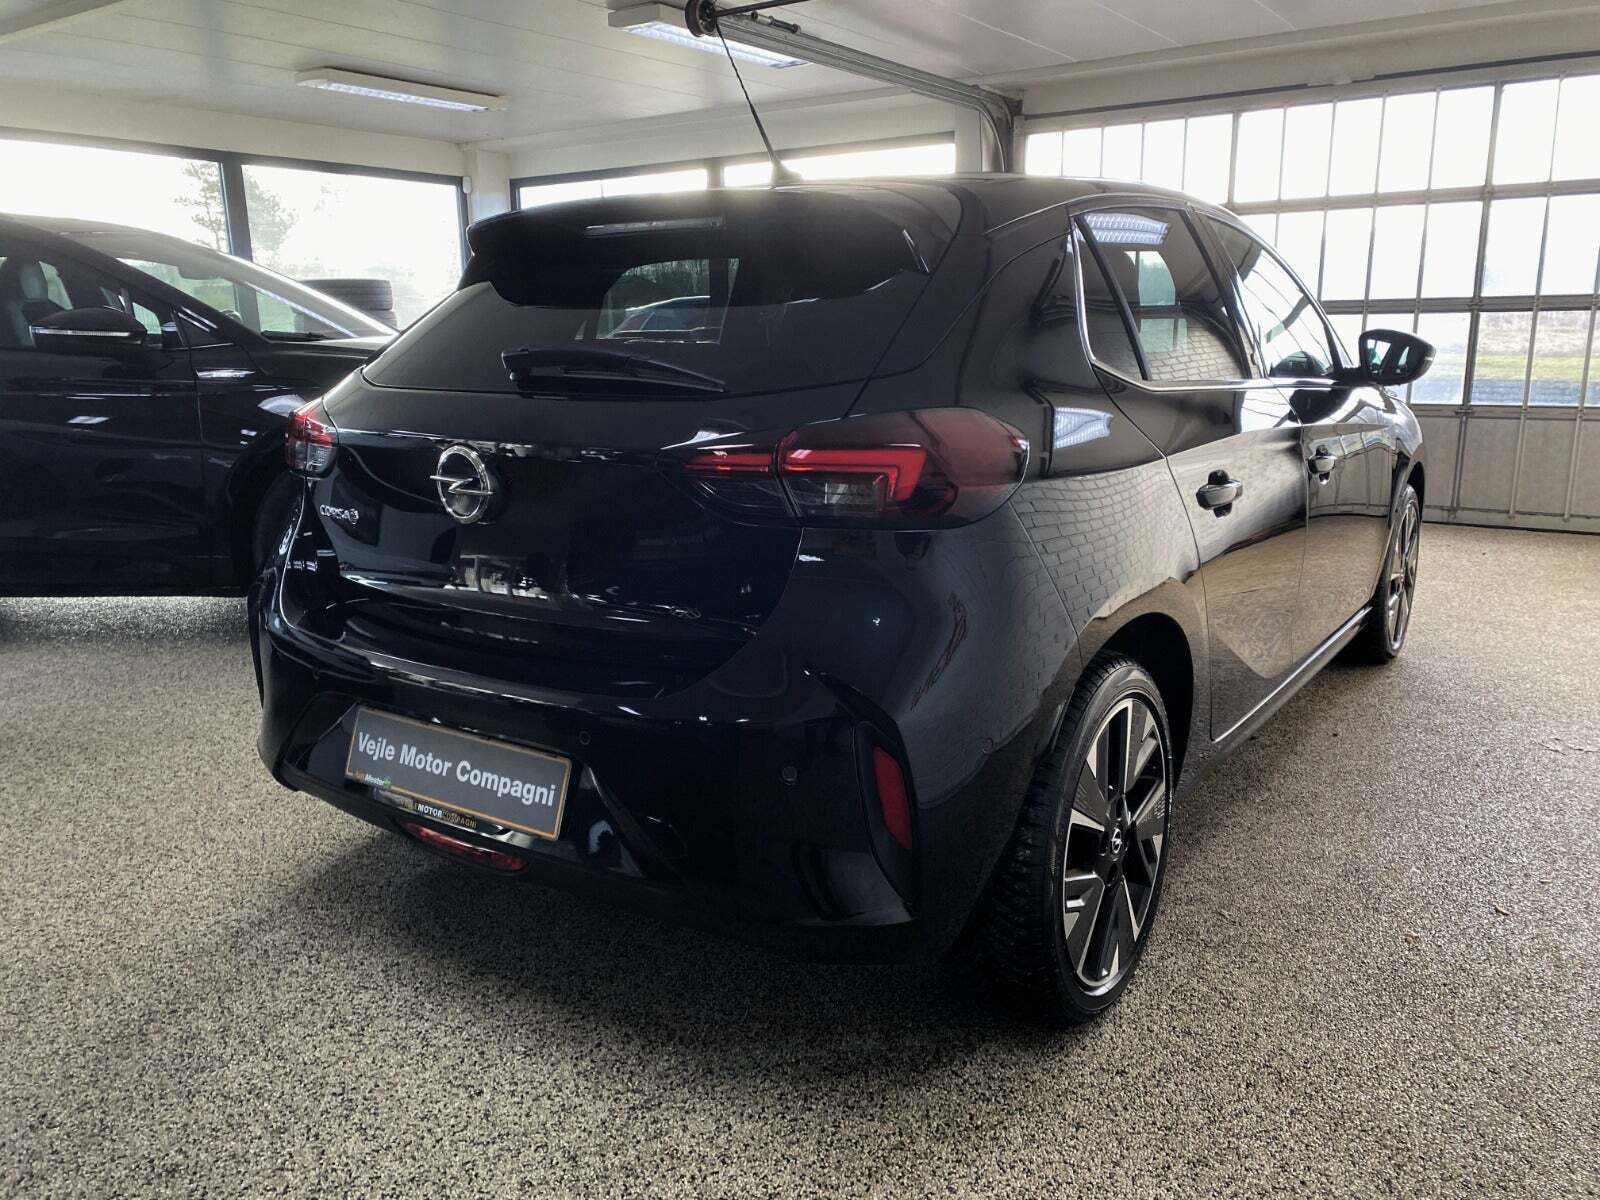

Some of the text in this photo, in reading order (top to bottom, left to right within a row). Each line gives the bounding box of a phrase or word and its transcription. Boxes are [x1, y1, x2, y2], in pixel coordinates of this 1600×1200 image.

[358, 732, 556, 807] Vejle Motor Compagni
